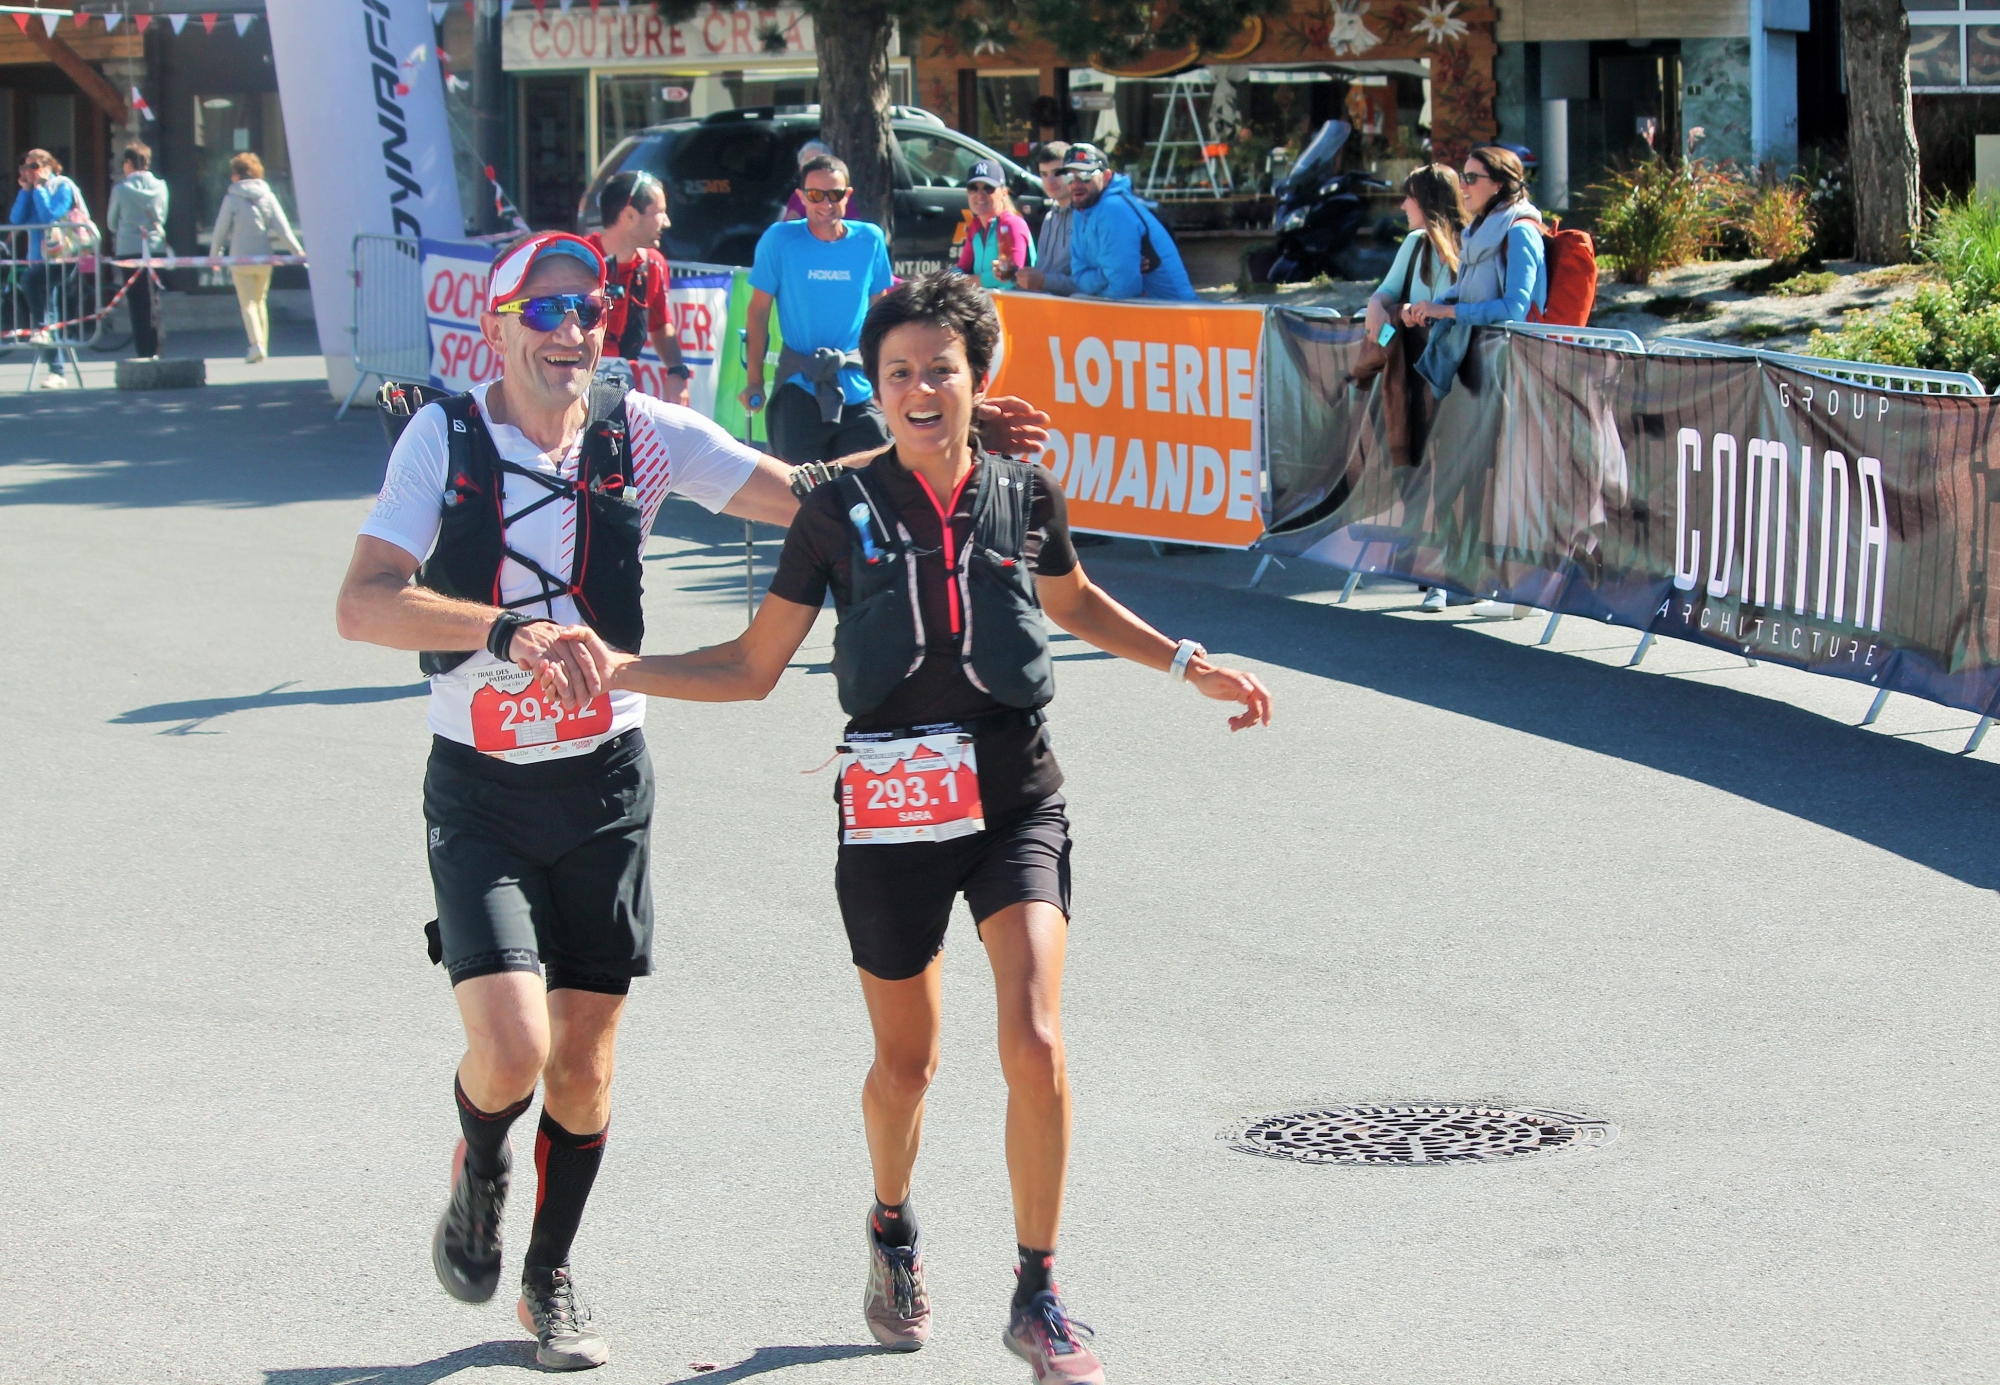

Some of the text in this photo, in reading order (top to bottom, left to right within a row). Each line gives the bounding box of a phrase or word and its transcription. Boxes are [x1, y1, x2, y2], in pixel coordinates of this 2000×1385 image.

[529, 10, 817, 58] COUTURE CREA
[893, 260, 942, 276] NTION
[428, 269, 488, 319] OCH
[440, 332, 505, 383] SPOR
[1048, 336, 1252, 420] LOTERIE
[1778, 382, 1890, 422] GROUP
[1022, 428, 1253, 521] OMANDE
[1673, 427, 1889, 632] COMINA
[1655, 598, 1877, 666] ARCHITECTURE
[477, 671, 494, 679] TRAIL
[488, 670, 534, 683] PATROUILLEU
[498, 697, 597, 731] 293.2
[866, 772, 958, 809] 293.1
[897, 810, 933, 822] SARA
